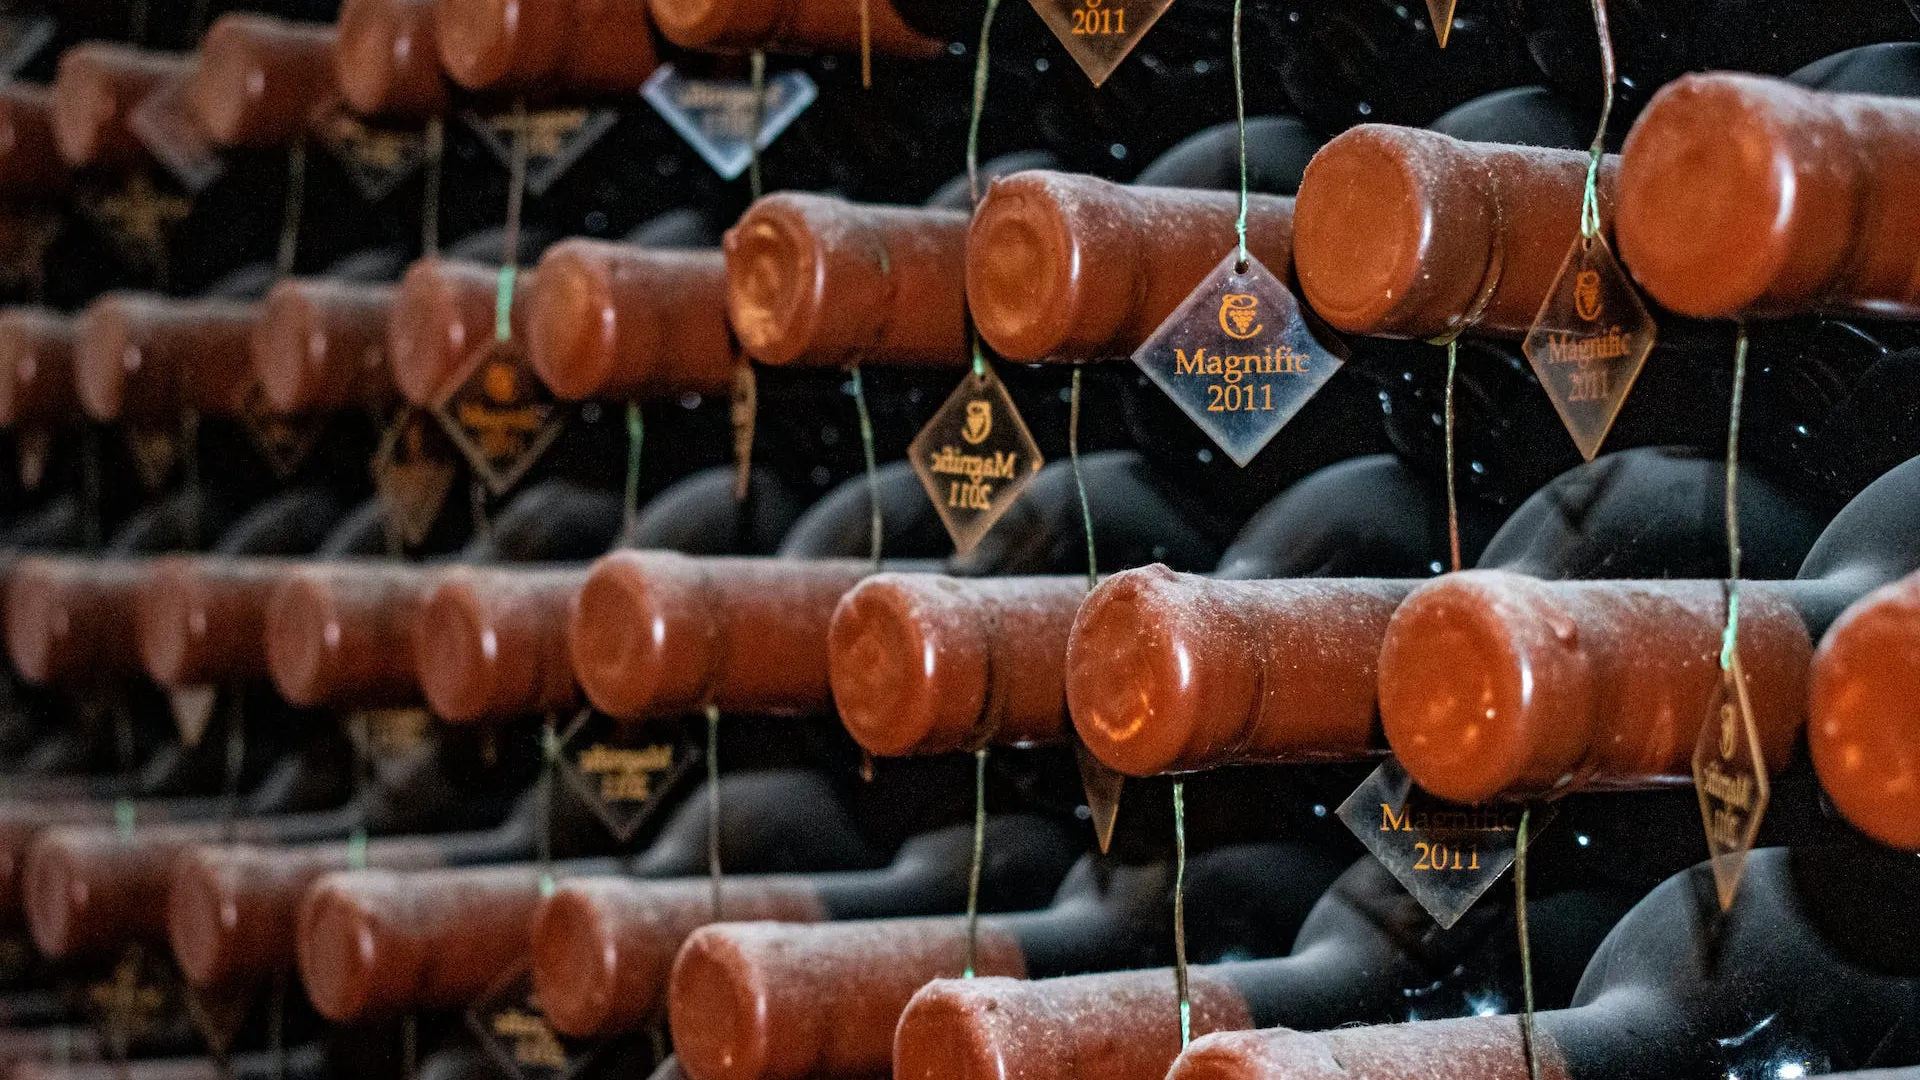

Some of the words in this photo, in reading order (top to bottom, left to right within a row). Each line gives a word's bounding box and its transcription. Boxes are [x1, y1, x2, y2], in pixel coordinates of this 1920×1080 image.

[1072, 8, 1126, 35] 2011
[1547, 325, 1632, 369] Magnific
[1174, 347, 1311, 384] Magnific
[1206, 383, 1277, 411] 2011
[1568, 370, 1609, 402] 2011
[1412, 841, 1480, 870] 2011
